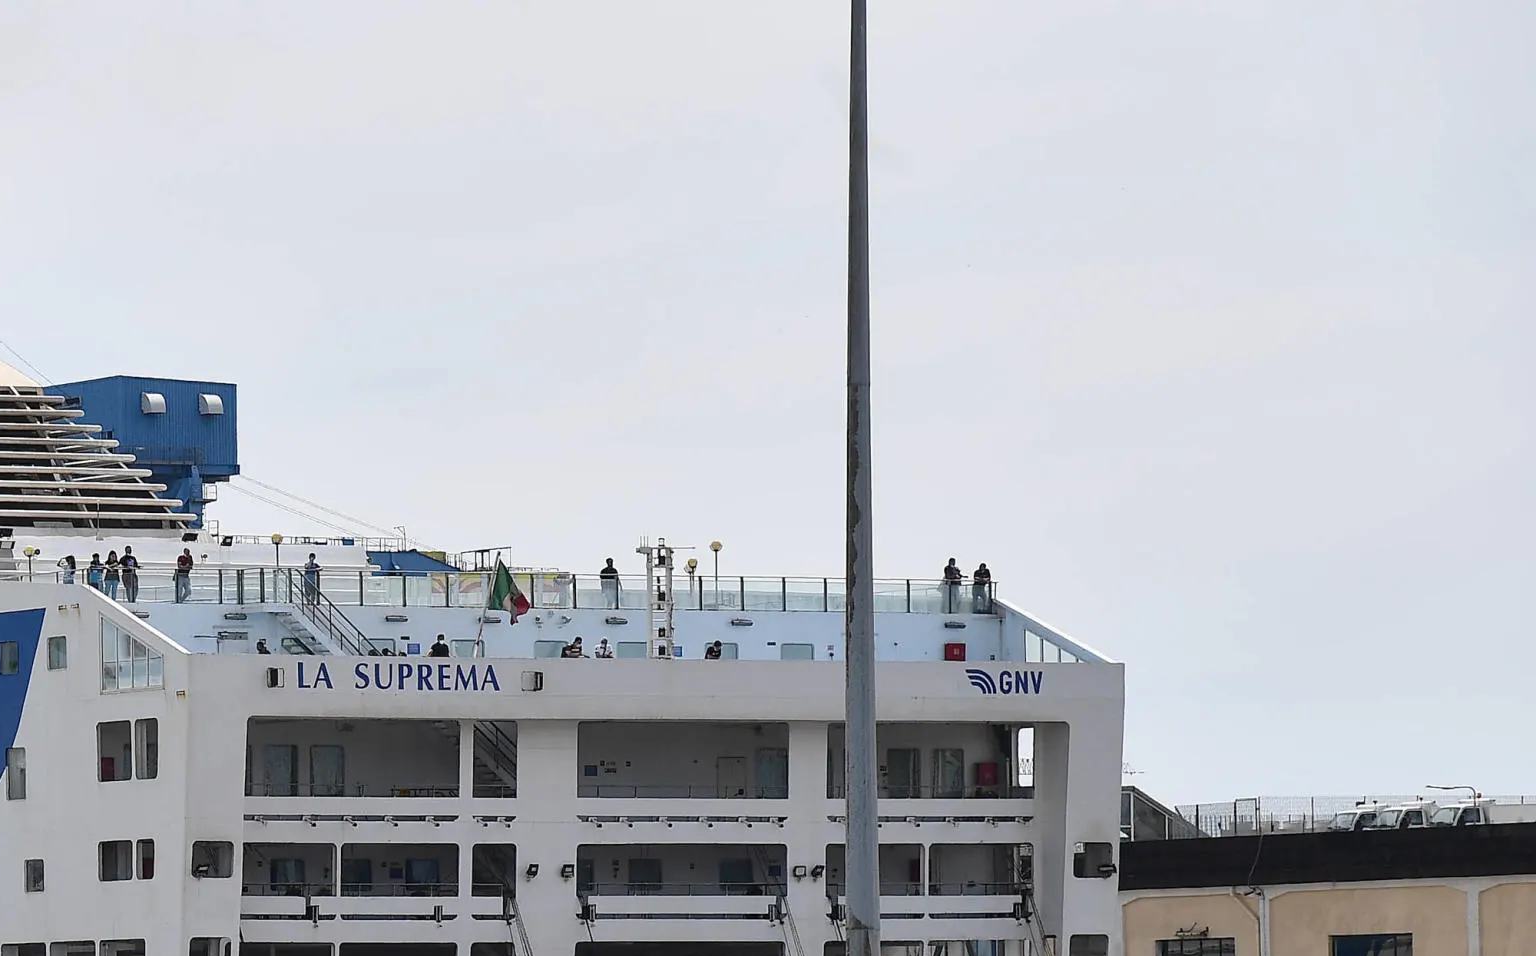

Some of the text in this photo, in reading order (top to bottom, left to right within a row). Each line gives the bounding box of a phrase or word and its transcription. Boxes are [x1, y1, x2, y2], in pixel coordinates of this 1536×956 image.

[296, 662, 501, 691] LA SUPREMA
[999, 671, 1044, 695] GNV
